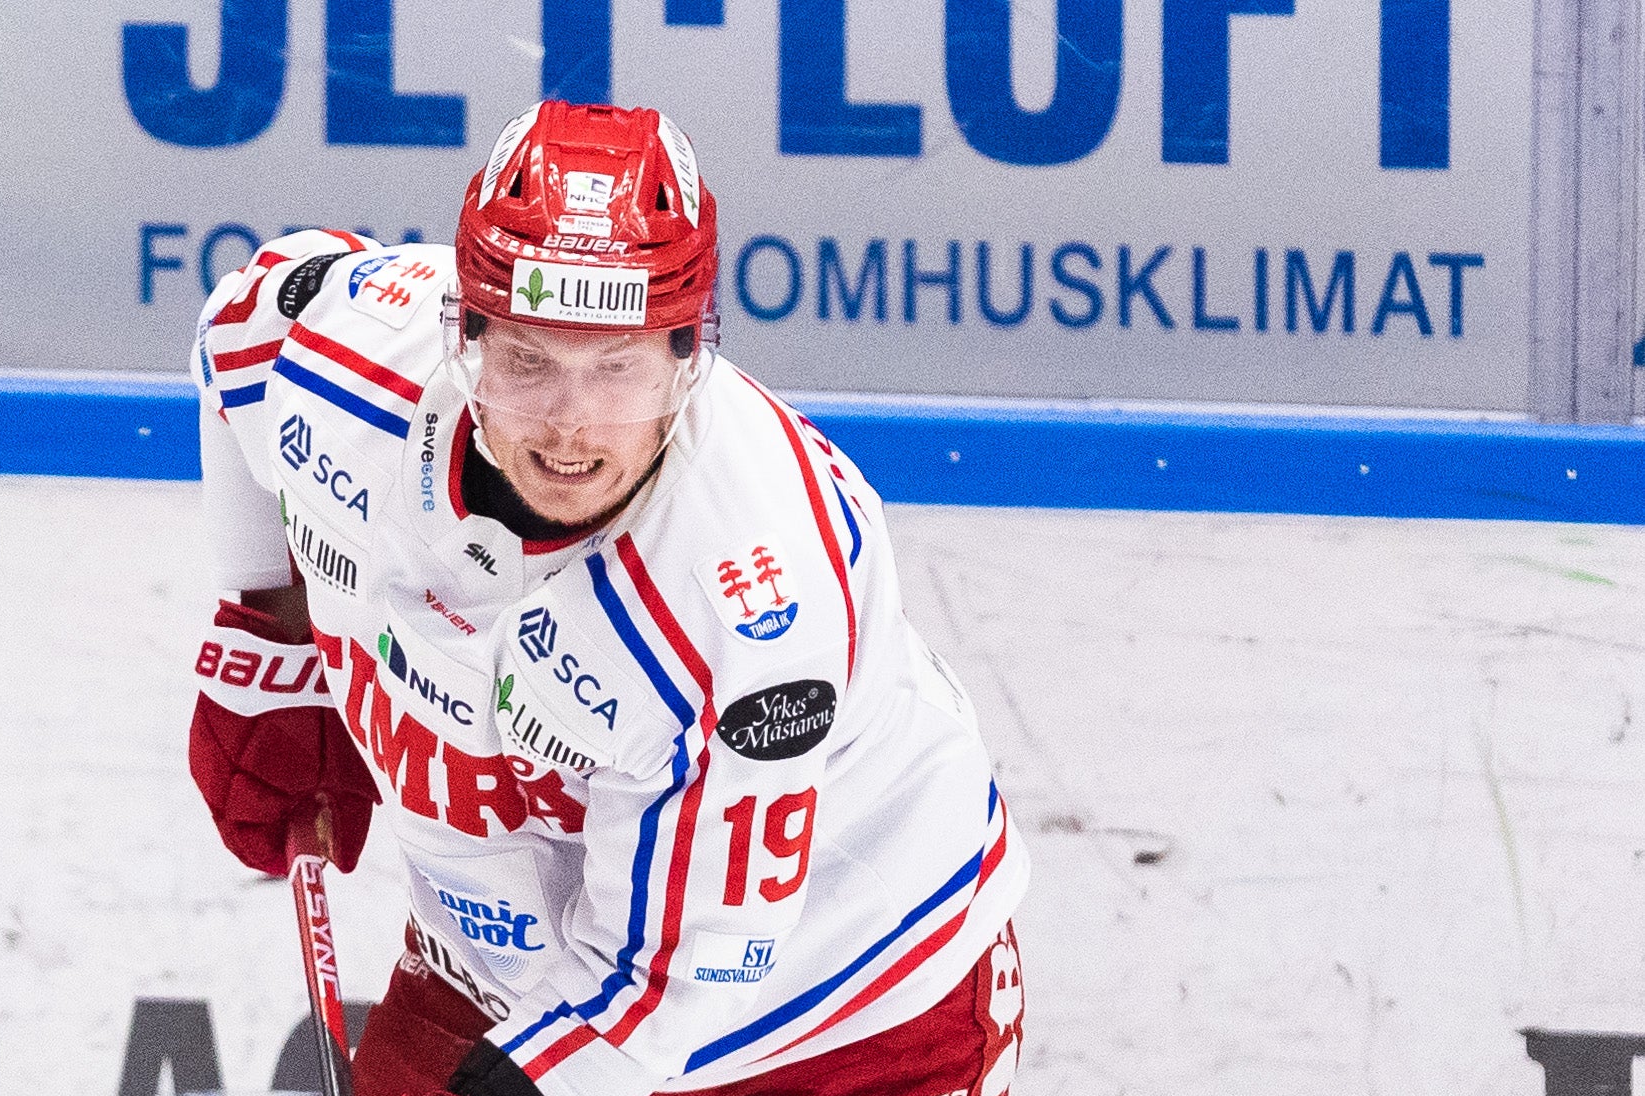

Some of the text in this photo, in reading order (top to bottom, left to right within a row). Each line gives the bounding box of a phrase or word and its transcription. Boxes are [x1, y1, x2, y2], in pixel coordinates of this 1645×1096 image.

[543, 235, 629, 256] BAUER
[559, 278, 645, 312] LILIUM
[735, 234, 1487, 338] OMHUSKLIMAT
[312, 454, 370, 523] SCA
[293, 514, 358, 590] LILIUM
[463, 542, 499, 577] SHL
[748, 609, 792, 639] TIMRÅ IK
[408, 667, 476, 728] NHC
[552, 653, 619, 732] SCA
[752, 692, 807, 726] Yrkes
[722, 785, 818, 907] 19
